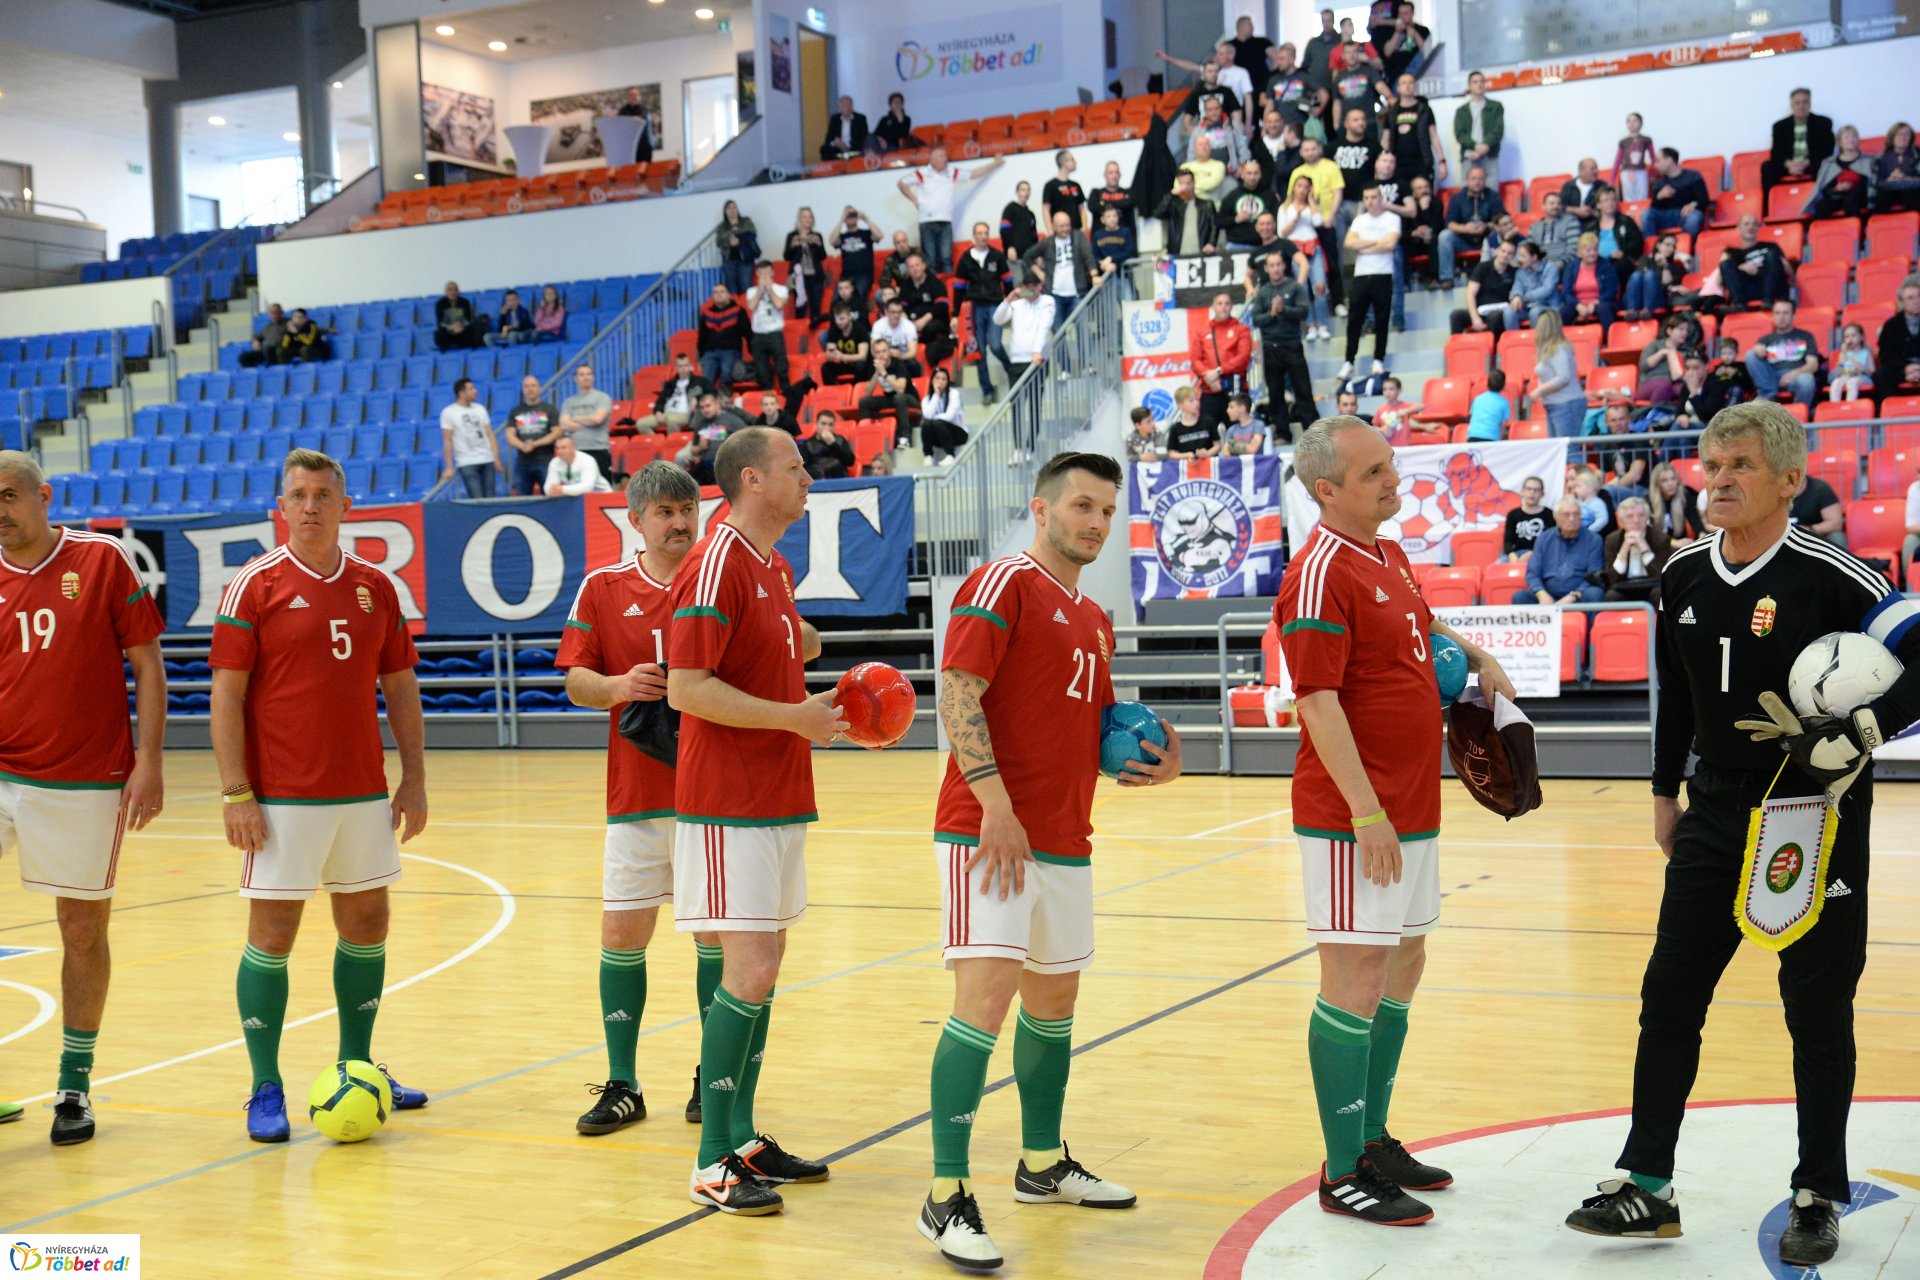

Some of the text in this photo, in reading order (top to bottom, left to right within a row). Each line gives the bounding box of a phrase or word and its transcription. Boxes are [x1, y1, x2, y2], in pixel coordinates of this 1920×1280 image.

[939, 41, 1044, 77] Többet ad!
[1139, 320, 1162, 334] 1928
[16, 608, 56, 653] 19
[330, 619, 352, 660] 5
[1405, 612, 1427, 662] 3
[1438, 613, 1552, 626] kozmetika
[1066, 647, 1096, 703] 21
[1719, 637, 1731, 692] 1
[1824, 887, 1852, 898] adidas
